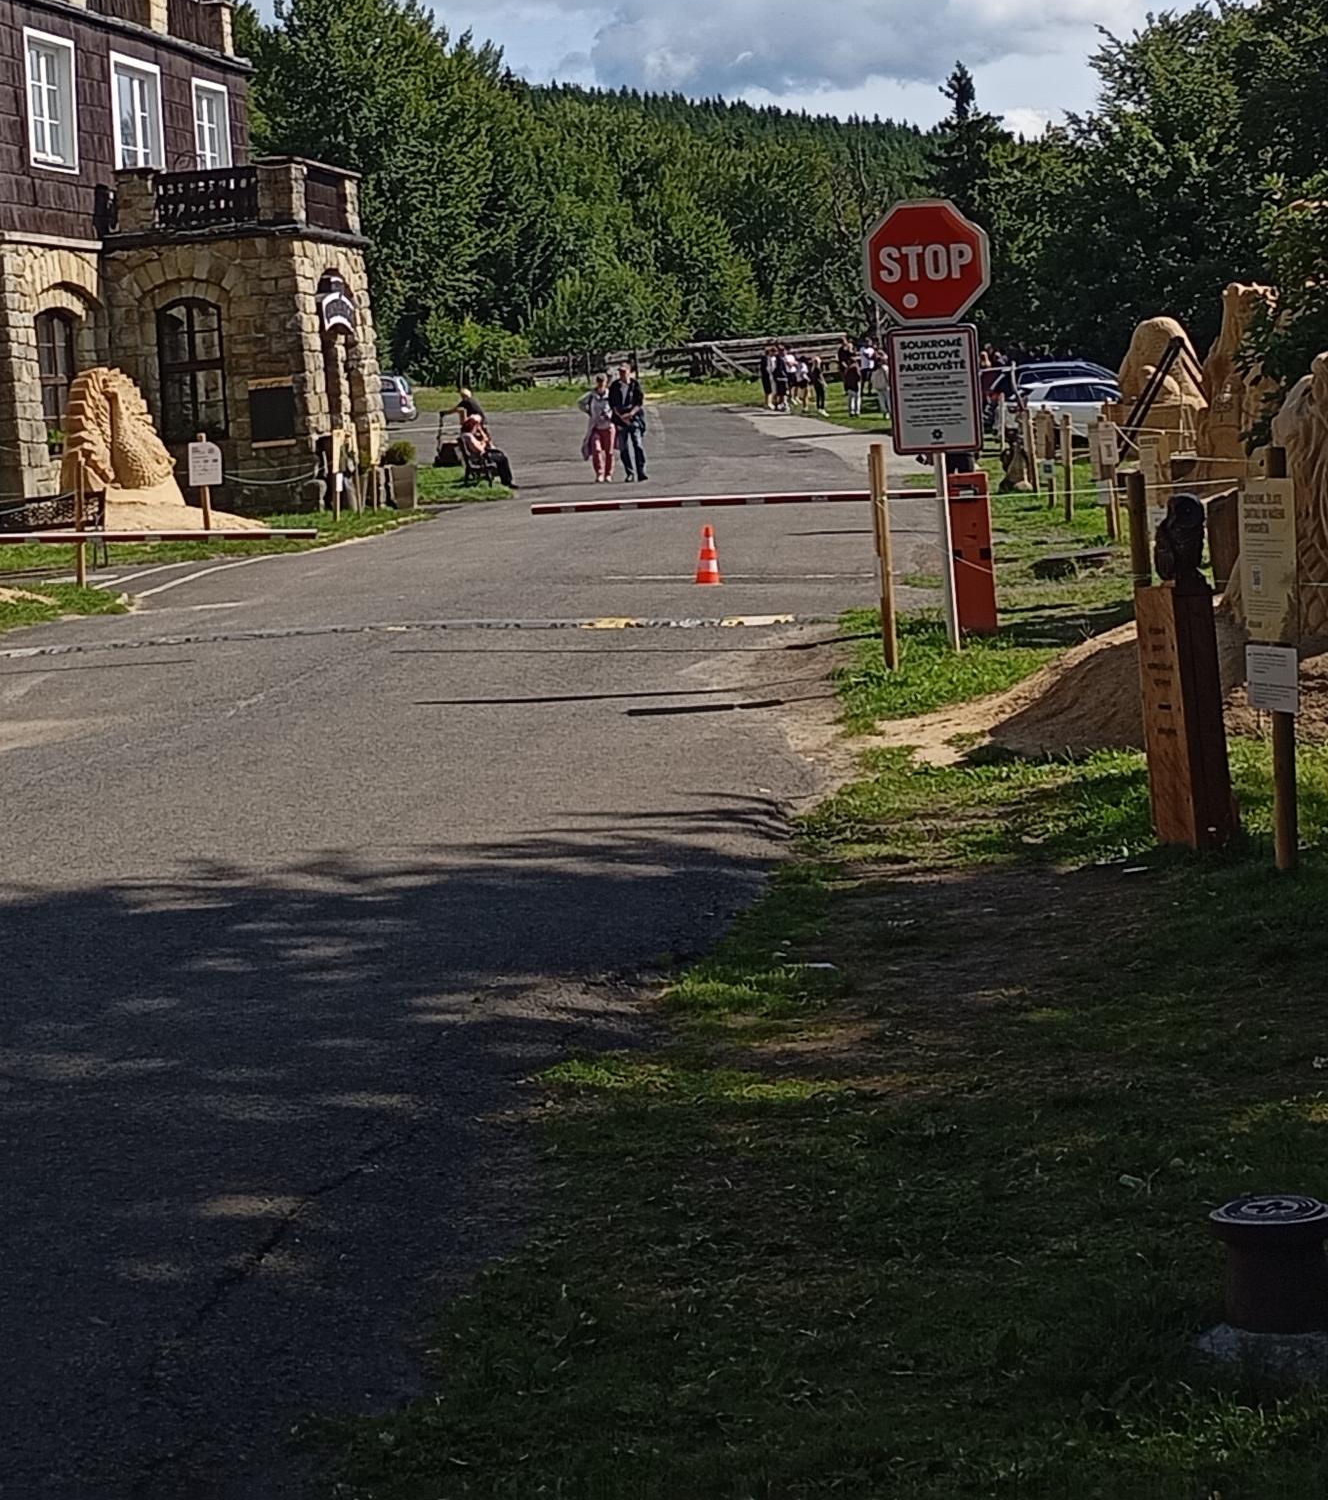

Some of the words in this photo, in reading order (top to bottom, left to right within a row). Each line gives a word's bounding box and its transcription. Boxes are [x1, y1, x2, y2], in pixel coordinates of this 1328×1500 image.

[879, 243, 973, 283] STOP
[900, 338, 962, 350] SOUKROMÉ
[903, 349, 961, 361] HOTELOVÉ
[899, 360, 966, 372] PARKOVIŠTĚ
